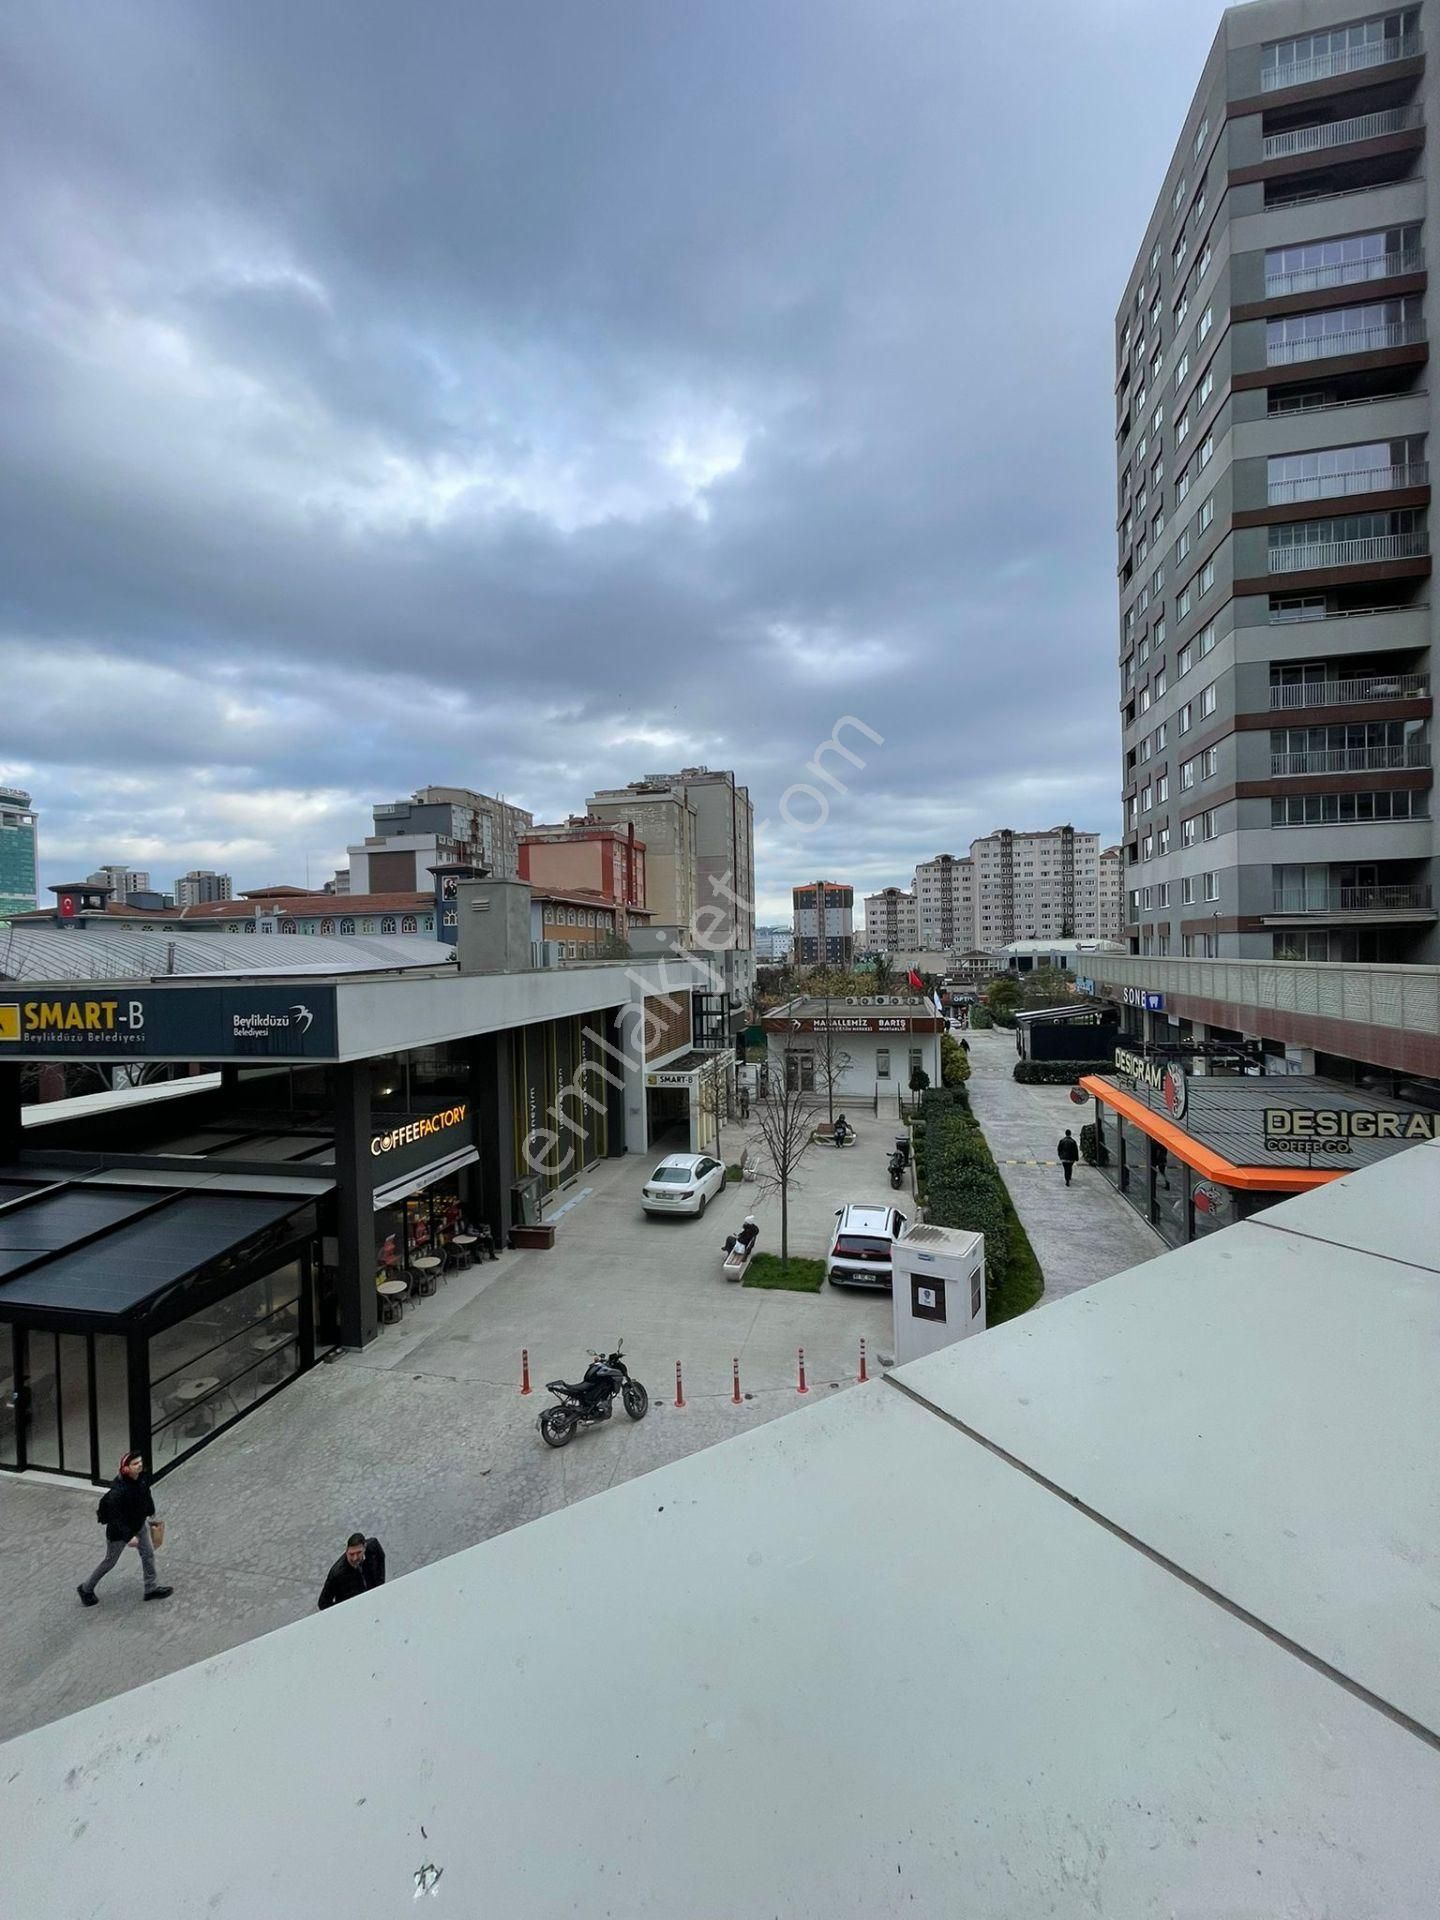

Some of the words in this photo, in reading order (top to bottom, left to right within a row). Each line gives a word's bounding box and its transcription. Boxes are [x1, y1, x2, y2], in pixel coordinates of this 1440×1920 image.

[24, 1001, 144, 1030] SMART-B
[233, 1014, 289, 1028] Beylikdüzü
[878, 1019, 906, 1028] BARIŞ
[24, 1032, 83, 1043] Beylikdüzü
[88, 1032, 145, 1043] Belediyesi
[233, 1027, 269, 1038] Belediyesi
[1115, 1047, 1162, 1090] DESIGRAM
[1267, 1110, 1440, 1138] DESIGRA
[1267, 1141, 1320, 1152] COFFEE
